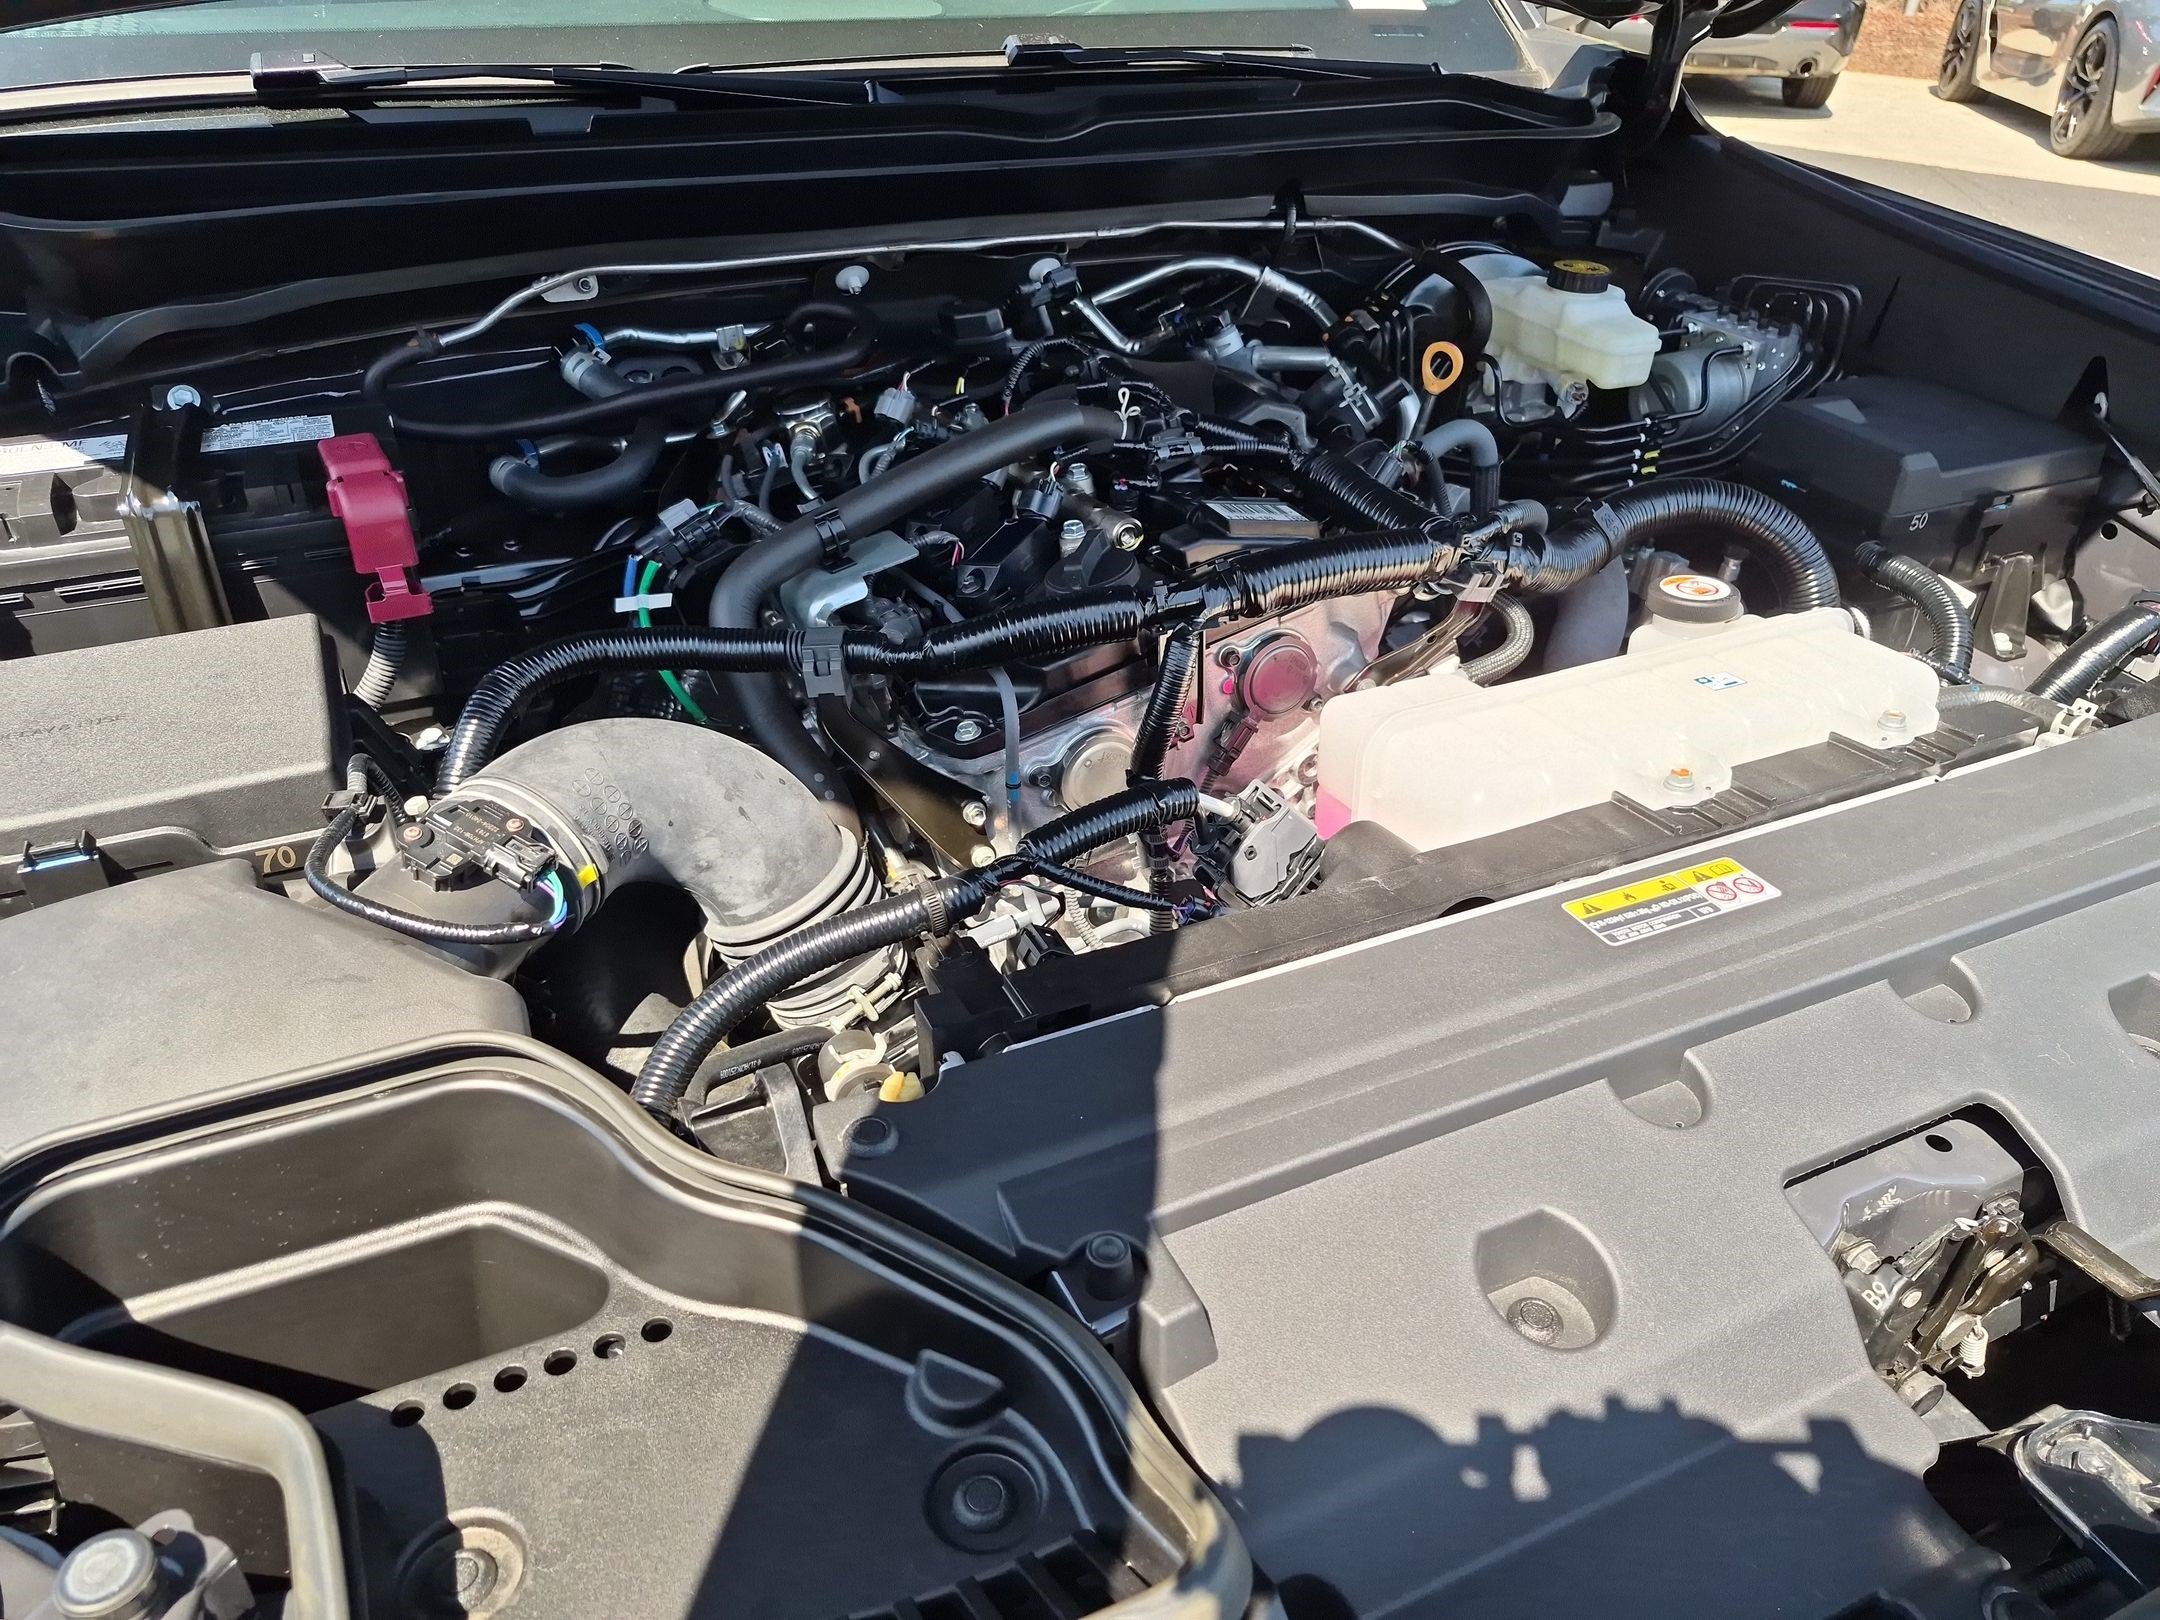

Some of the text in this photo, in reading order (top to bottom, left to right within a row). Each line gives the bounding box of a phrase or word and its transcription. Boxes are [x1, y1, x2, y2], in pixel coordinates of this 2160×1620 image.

[1908, 511, 1929, 532] 50
[254, 845, 296, 874] 70
[1861, 1281, 1890, 1311] B9
